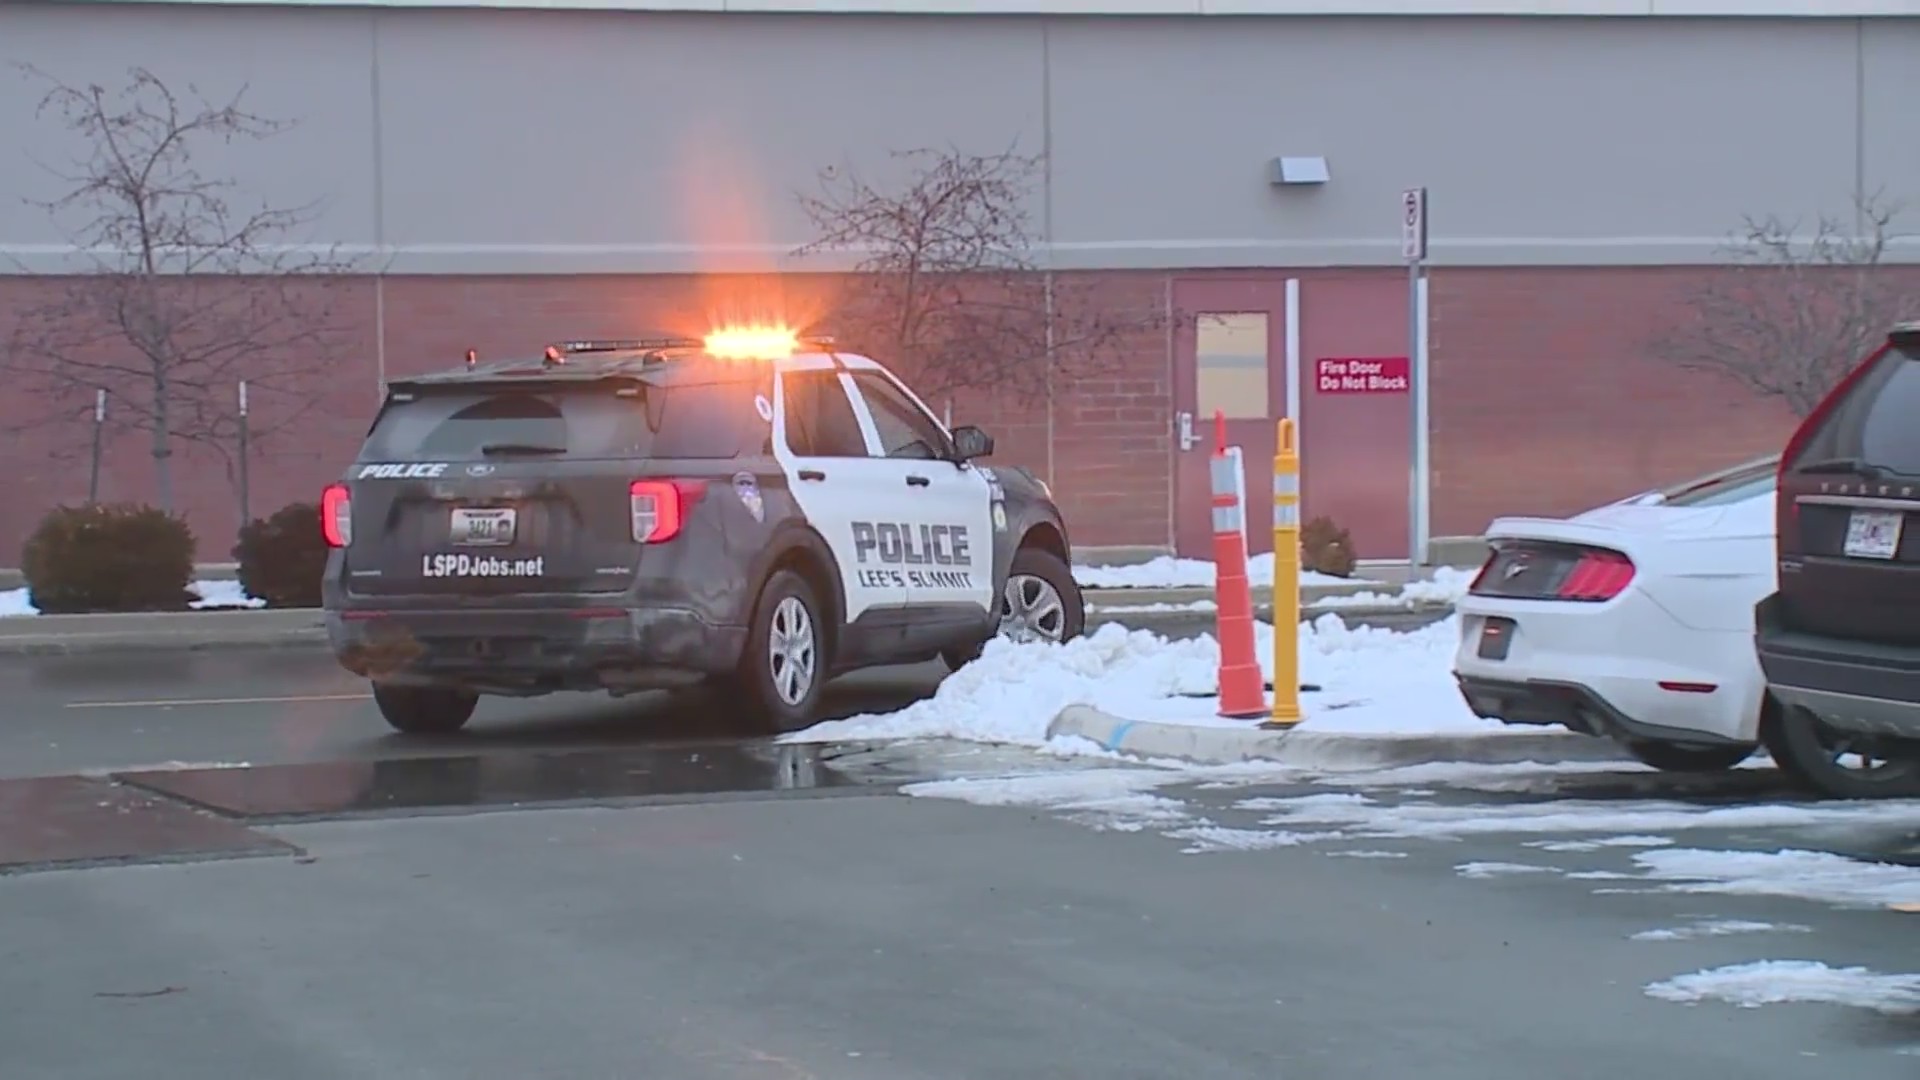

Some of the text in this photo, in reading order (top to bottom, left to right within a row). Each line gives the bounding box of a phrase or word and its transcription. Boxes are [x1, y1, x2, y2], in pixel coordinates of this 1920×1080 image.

[1320, 361, 1382, 374] Fire Door
[1320, 376, 1407, 390] Do Not Block
[358, 463, 449, 479] POLICE
[851, 521, 971, 566] POLICE
[423, 554, 544, 577] LSPDJobs.net
[858, 569, 972, 588] LEE'S SUMMIT
